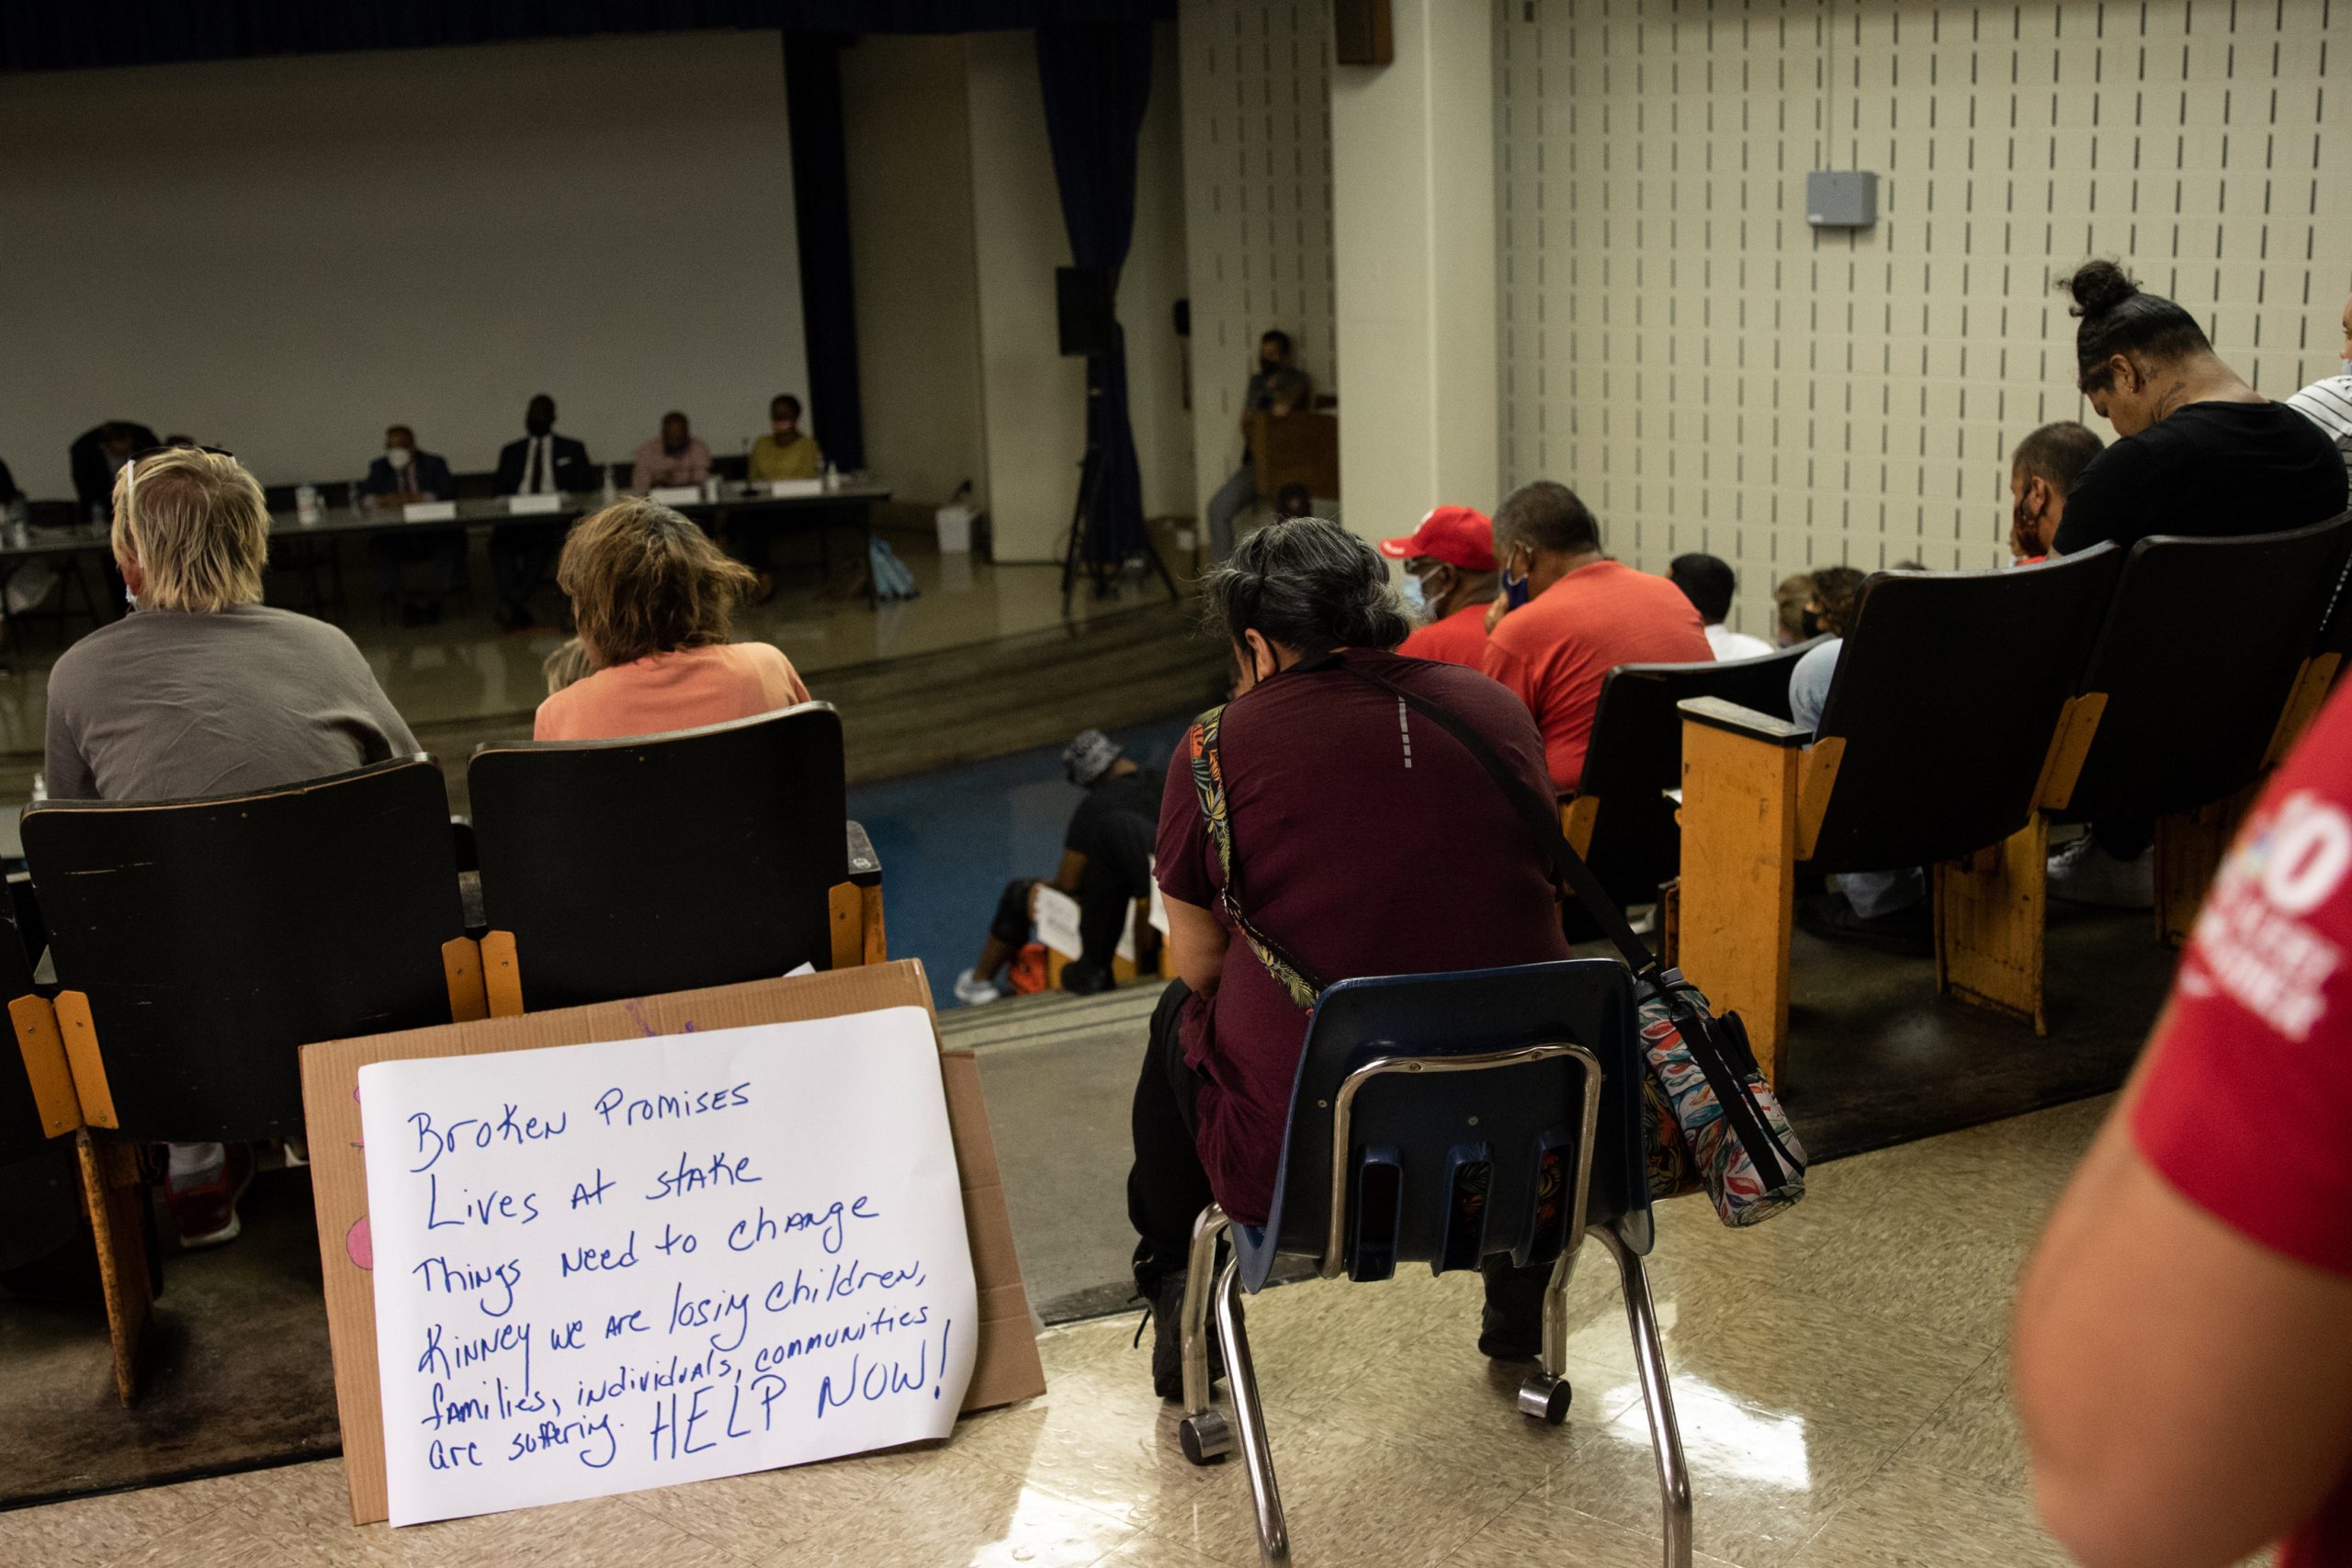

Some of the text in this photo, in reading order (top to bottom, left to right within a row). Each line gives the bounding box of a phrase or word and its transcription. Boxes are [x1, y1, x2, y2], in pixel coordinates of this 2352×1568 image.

[408, 1082, 752, 1173] Broken Promises
[427, 1174, 540, 1229] Lives
[413, 1256, 523, 1317] Things
[654, 1224, 698, 1256] to
[417, 1323, 531, 1398] Kinney
[428, 1438, 484, 1470] are
[649, 1373, 787, 1462] HELP
[817, 1317, 952, 1419] NOW!
